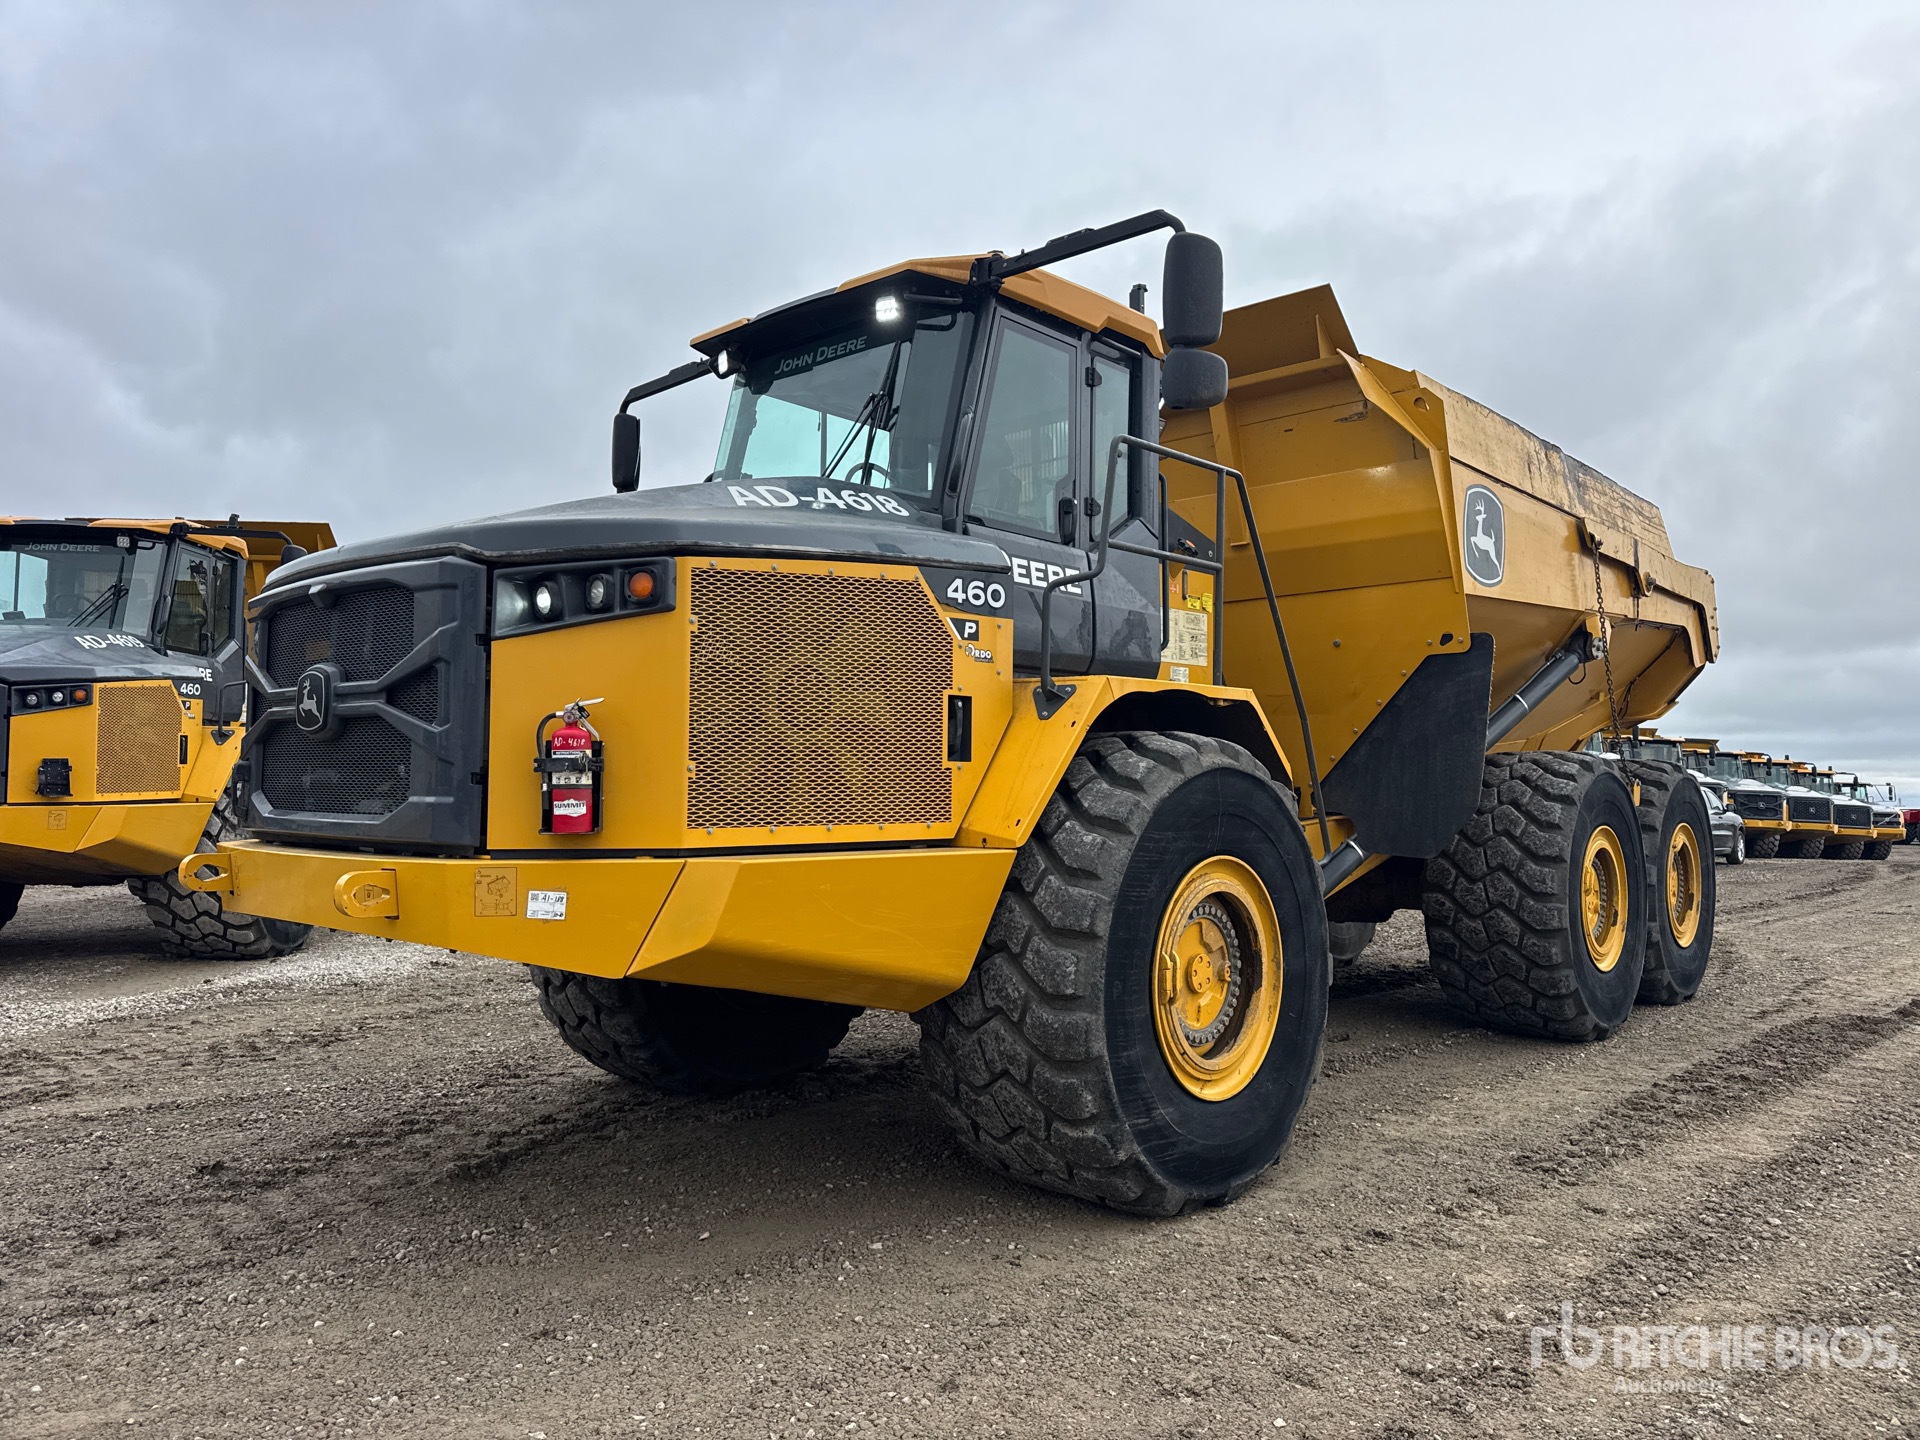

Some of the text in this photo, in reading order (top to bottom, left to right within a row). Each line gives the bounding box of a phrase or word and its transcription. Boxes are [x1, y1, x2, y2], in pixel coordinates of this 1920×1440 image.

[774, 335, 868, 375] JOHN DEERE
[727, 485, 910, 517] AD-4618
[25, 542, 100, 553] JOHN DEERE
[1002, 549, 1082, 594] EERE
[947, 578, 1006, 608] 460
[963, 621, 977, 639] P
[180, 682, 201, 696] 460
[185, 701, 191, 710] P
